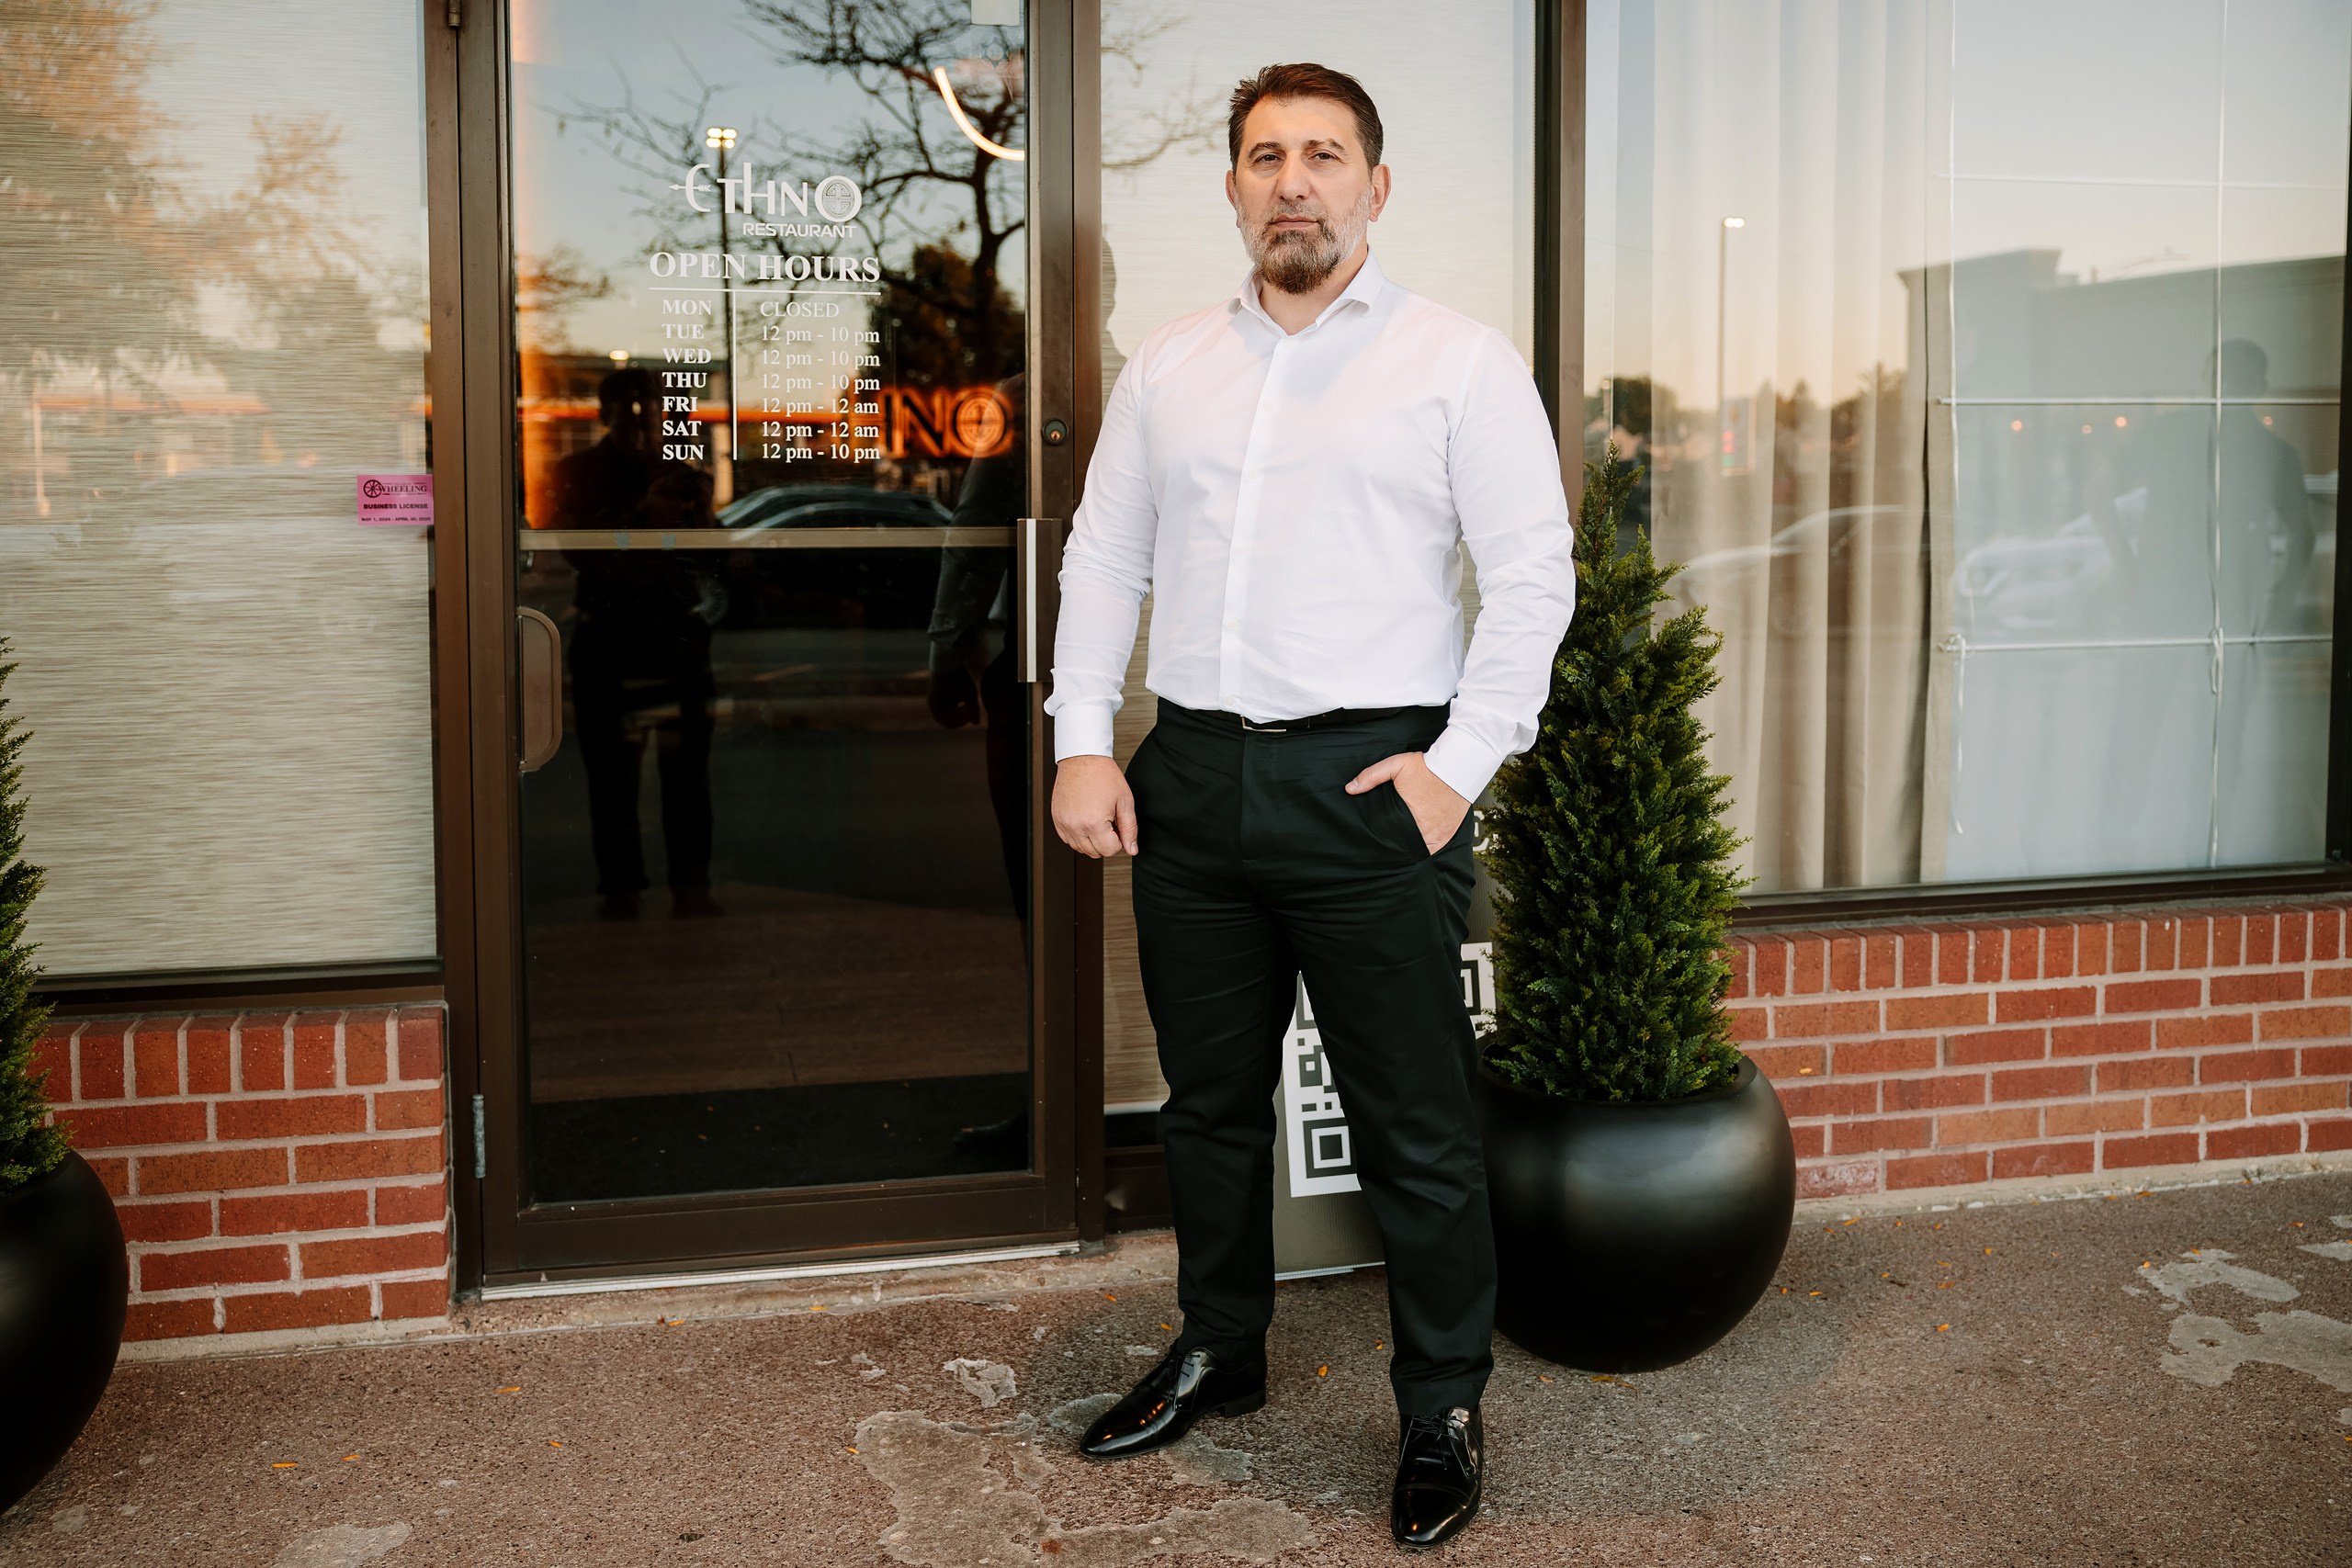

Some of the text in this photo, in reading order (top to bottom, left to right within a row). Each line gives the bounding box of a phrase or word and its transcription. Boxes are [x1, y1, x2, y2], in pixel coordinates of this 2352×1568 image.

[742, 223, 856, 238] RESTAURANT
[649, 252, 880, 283] OPEN HOURS
[662, 299, 839, 318] MON CLOSED
[662, 323, 705, 339] TUE
[762, 325, 781, 341] 12
[786, 330, 812, 344] pm
[831, 327, 849, 341] 10
[854, 331, 880, 345] pm
[662, 348, 712, 364] WED
[762, 349, 781, 365] 12
[786, 354, 812, 369] pm
[831, 351, 849, 366] 10
[854, 355, 880, 369] pm
[662, 372, 707, 388] THU
[762, 373, 781, 389] 12
[786, 378, 812, 392] pm
[831, 375, 849, 389] 10
[854, 378, 880, 393] pm
[662, 396, 698, 412] FRI
[762, 397, 781, 412] 12
[786, 401, 812, 416] pm
[831, 399, 849, 413] 12
[854, 403, 879, 413] am
[662, 420, 702, 436] SAT
[762, 422, 781, 437] 12
[786, 425, 812, 441] pm
[831, 423, 849, 437] 12
[854, 427, 879, 437] am
[662, 445, 705, 460] SUN
[762, 444, 781, 459] 12
[786, 447, 812, 463] pm
[831, 444, 849, 459] 10
[854, 448, 880, 463] pm
